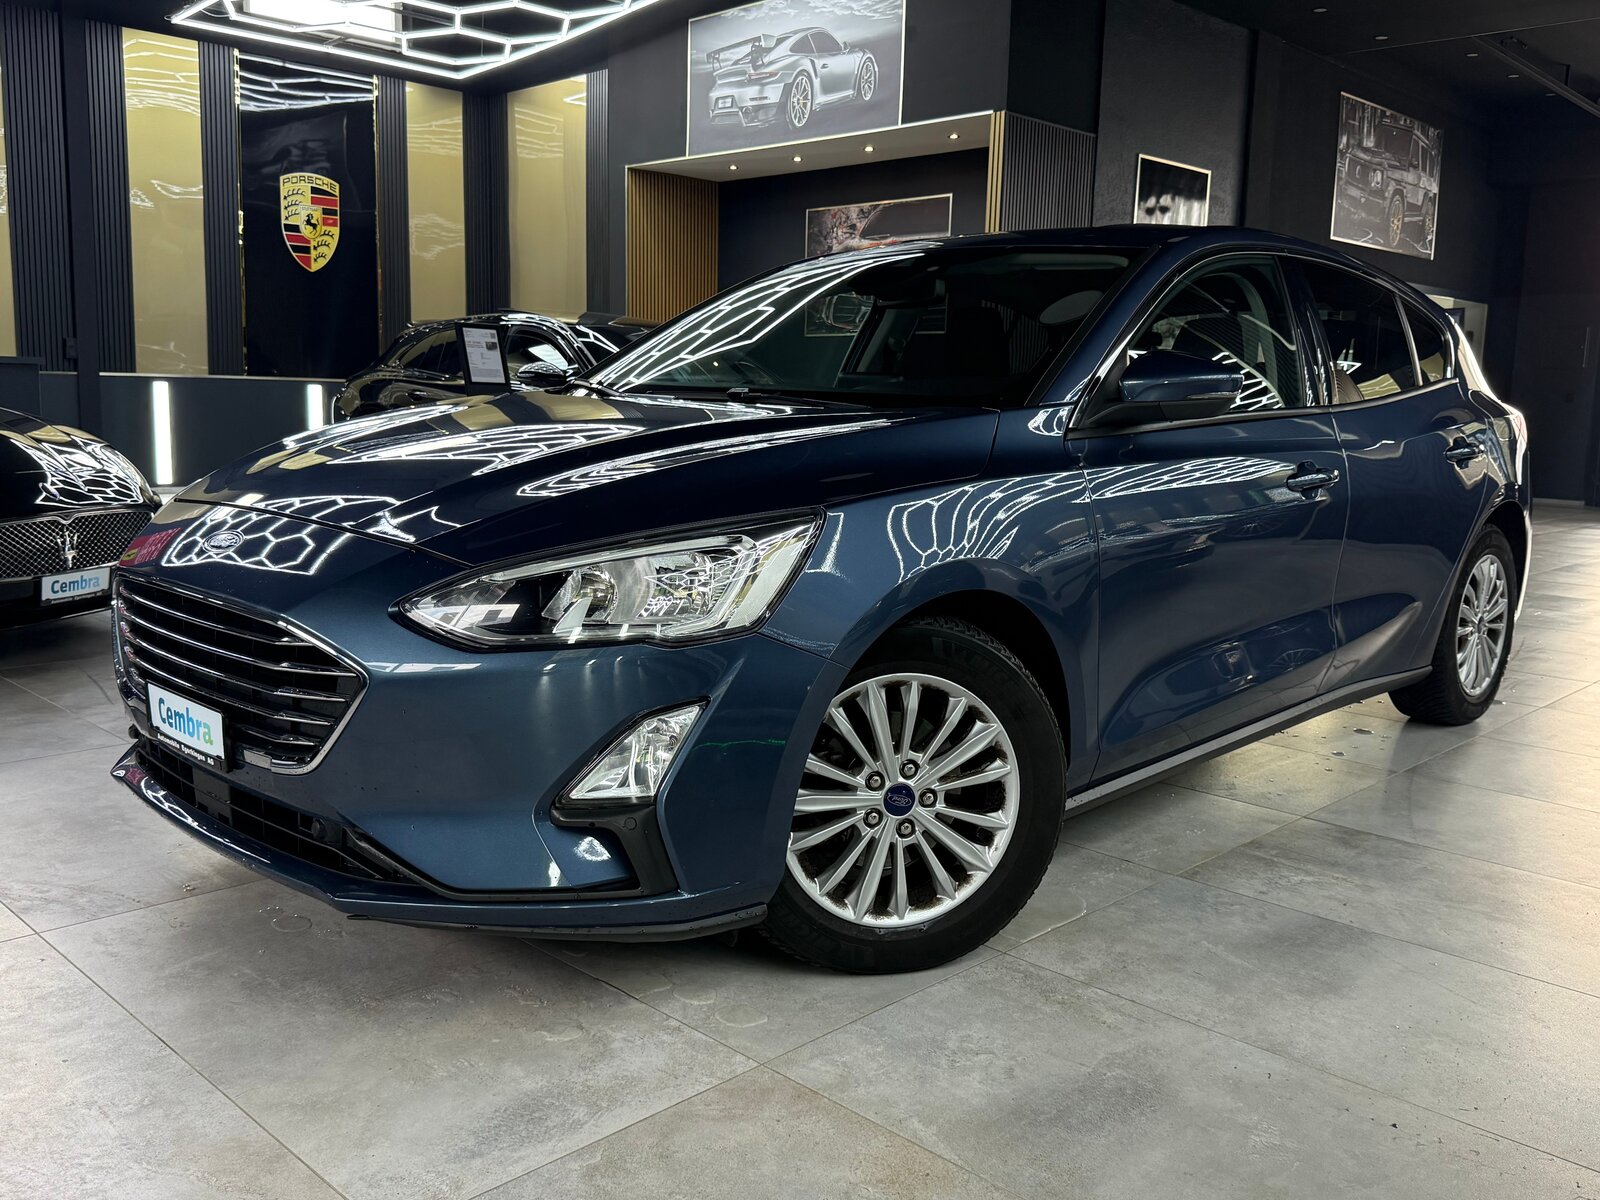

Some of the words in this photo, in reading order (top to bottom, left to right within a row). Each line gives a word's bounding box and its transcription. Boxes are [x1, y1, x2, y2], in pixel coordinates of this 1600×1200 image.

[282, 175, 337, 193] PORSCHE
[51, 575, 100, 594] Cembra
[158, 697, 213, 746] Cembra
